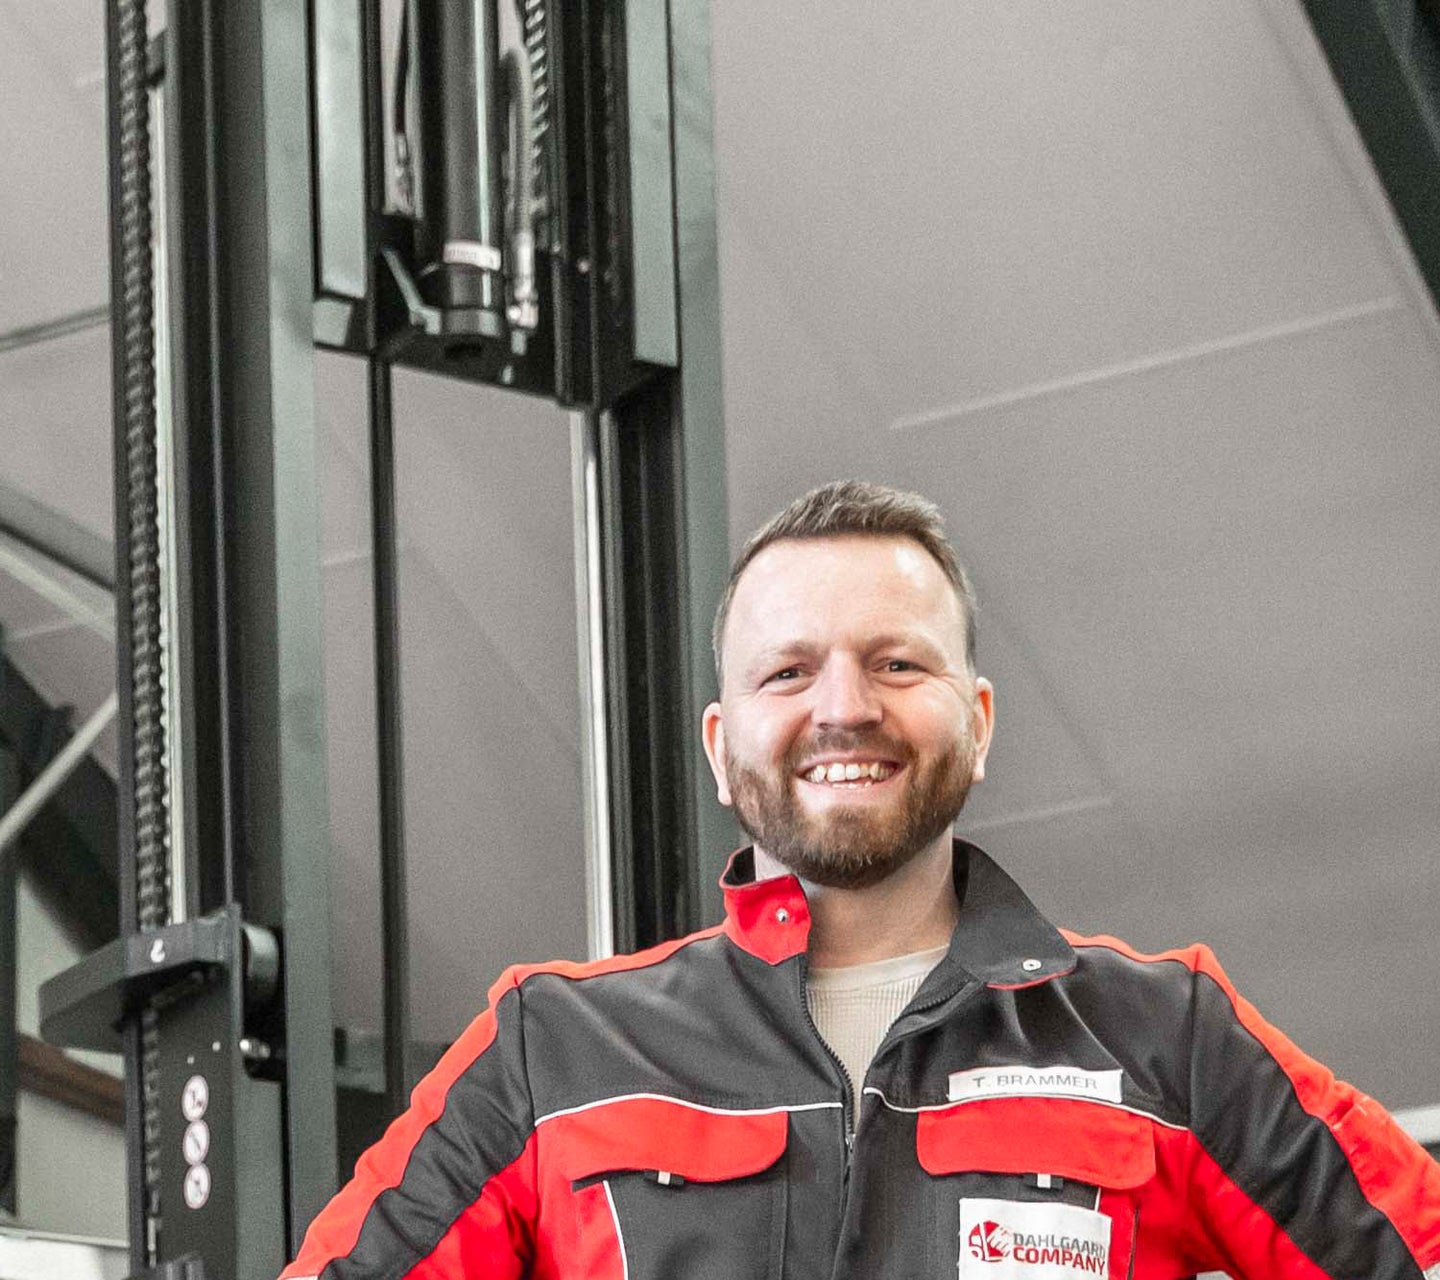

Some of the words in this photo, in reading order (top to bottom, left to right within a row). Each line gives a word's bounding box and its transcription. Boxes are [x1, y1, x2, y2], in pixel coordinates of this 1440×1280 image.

[997, 1074, 1097, 1090] BRAMMER
[1013, 1232, 1106, 1259] DAHLGAARD
[1013, 1246, 1105, 1275] COMPANY
